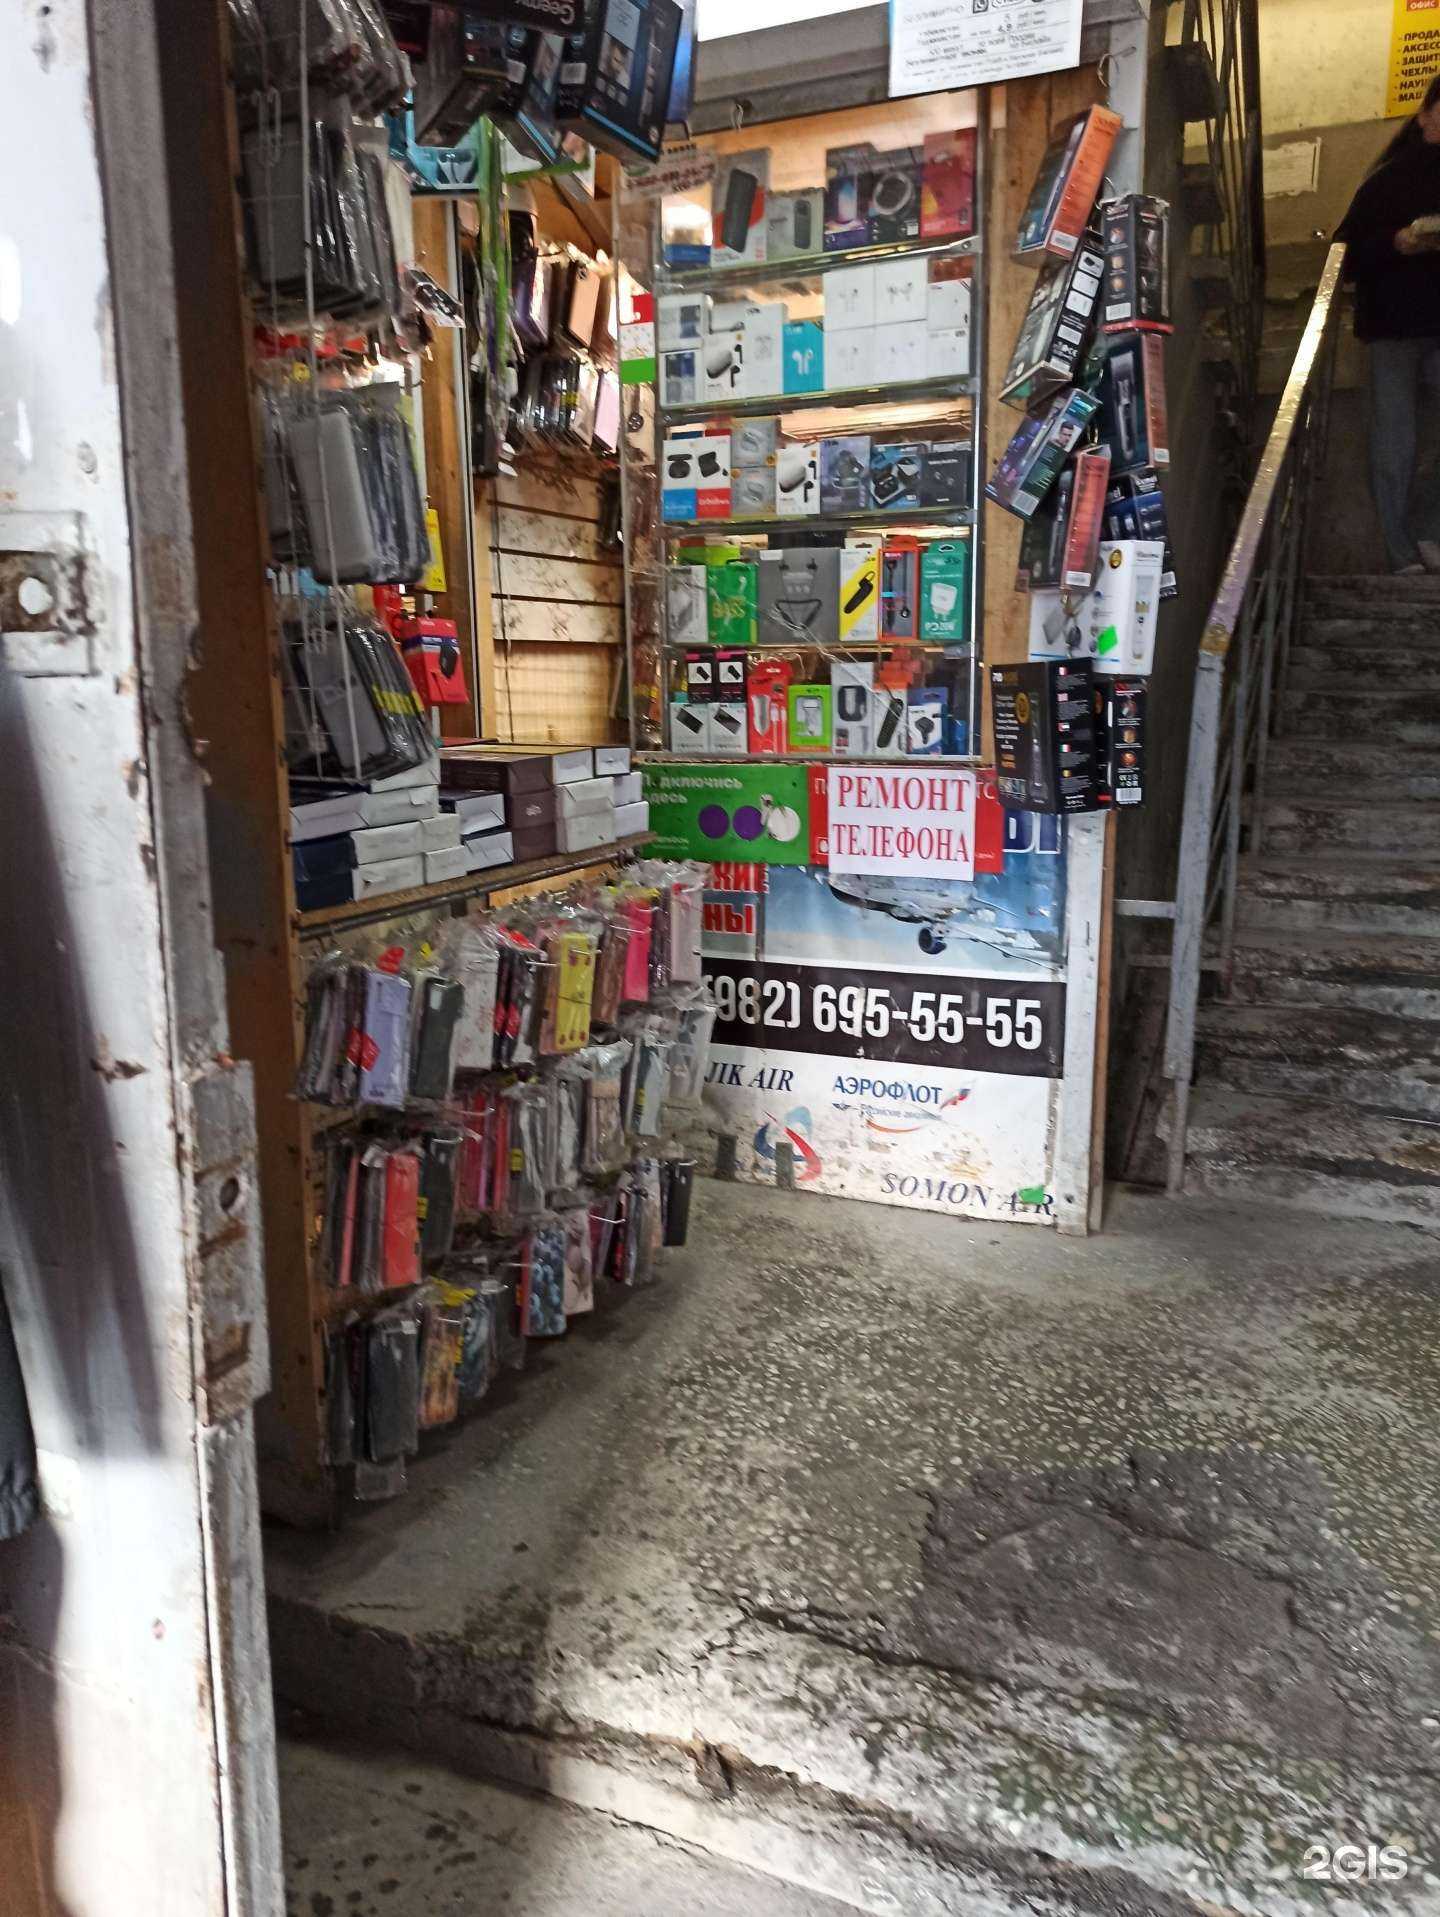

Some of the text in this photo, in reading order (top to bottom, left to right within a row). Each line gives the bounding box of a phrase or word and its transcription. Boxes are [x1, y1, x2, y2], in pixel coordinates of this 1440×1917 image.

[1401, 65, 1438, 77] ЧЕХЛЫ
[838, 775, 969, 813] РЕМОНТ
[832, 822, 970, 864] ТЕЛЕФОНА
[812, 984, 1043, 1050] 695-55-55
[750, 1067, 794, 1092] AIR
[881, 1172, 1056, 1217] SOMON AR
